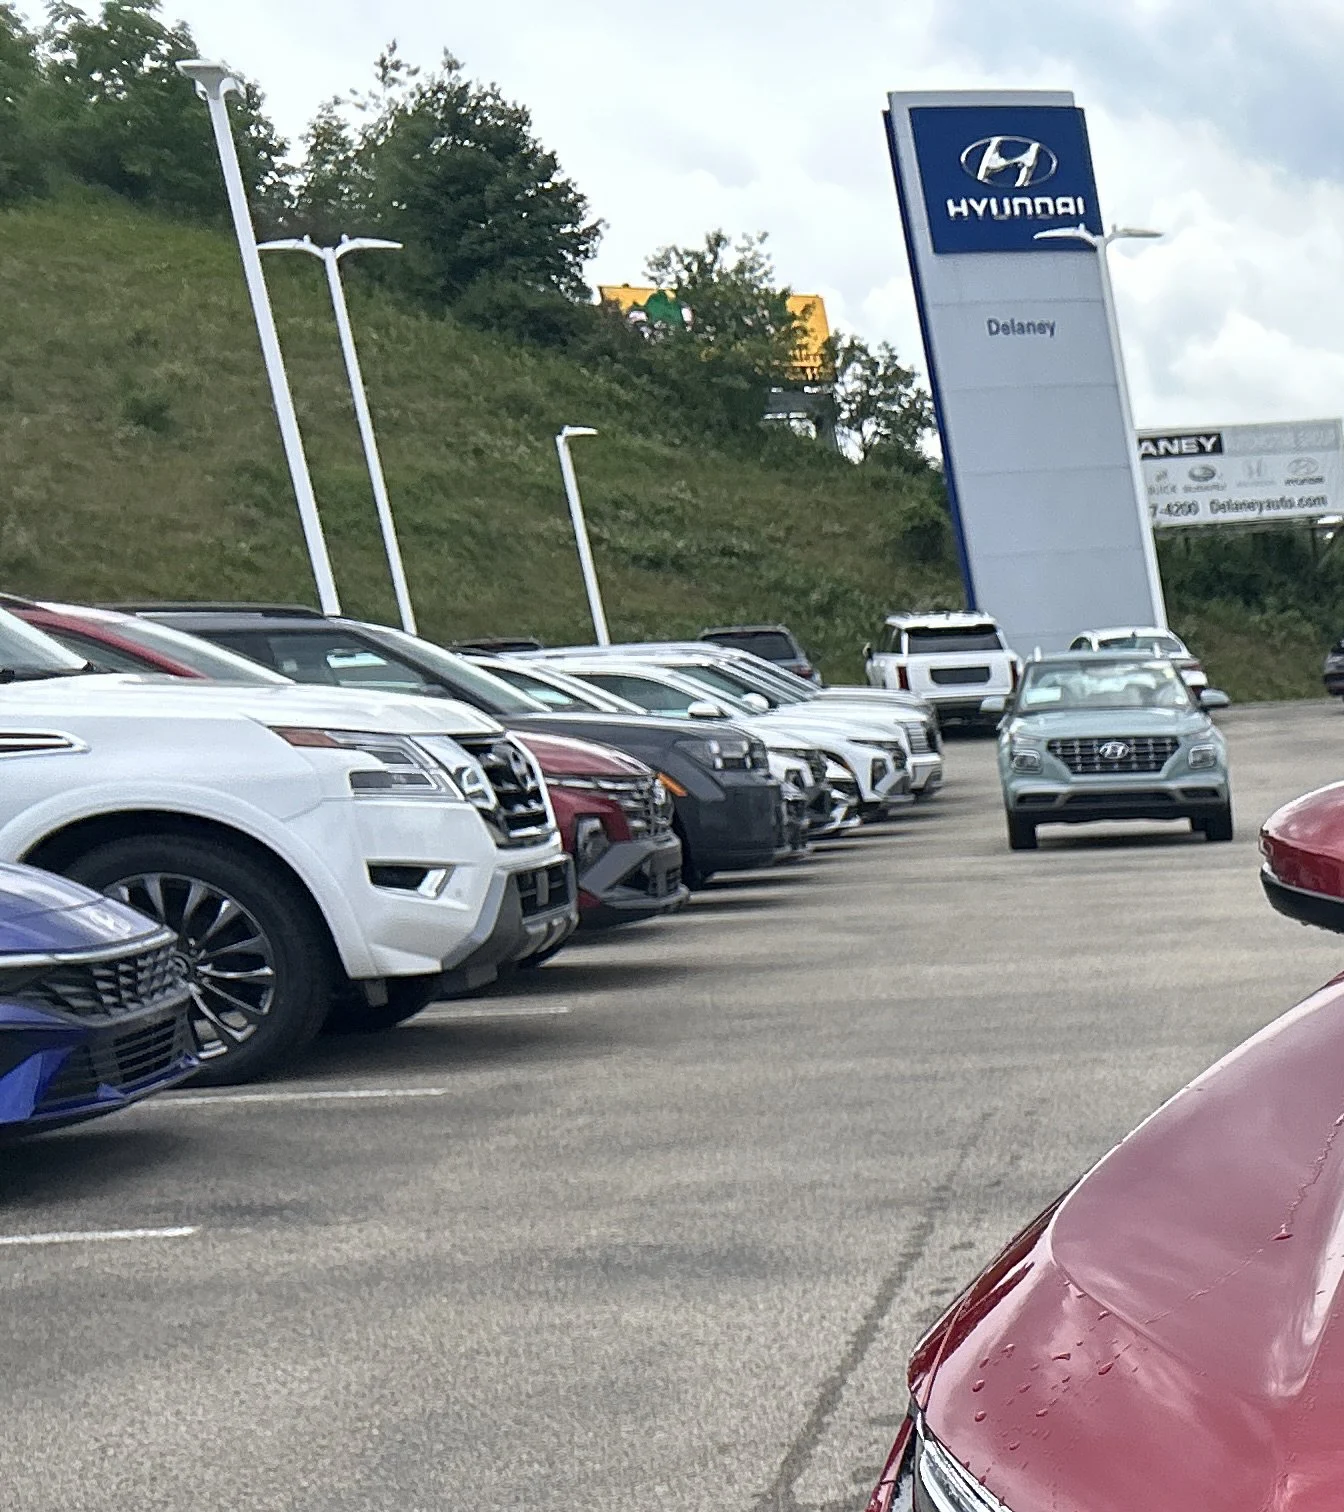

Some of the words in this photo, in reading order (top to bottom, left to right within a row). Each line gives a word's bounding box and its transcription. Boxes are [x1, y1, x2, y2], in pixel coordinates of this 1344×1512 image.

[946, 196, 1086, 219] HYUNDAI
[987, 317, 1056, 337] Delaney
[1140, 435, 1219, 456] ANEY
[1149, 500, 1200, 517] 7-4200
